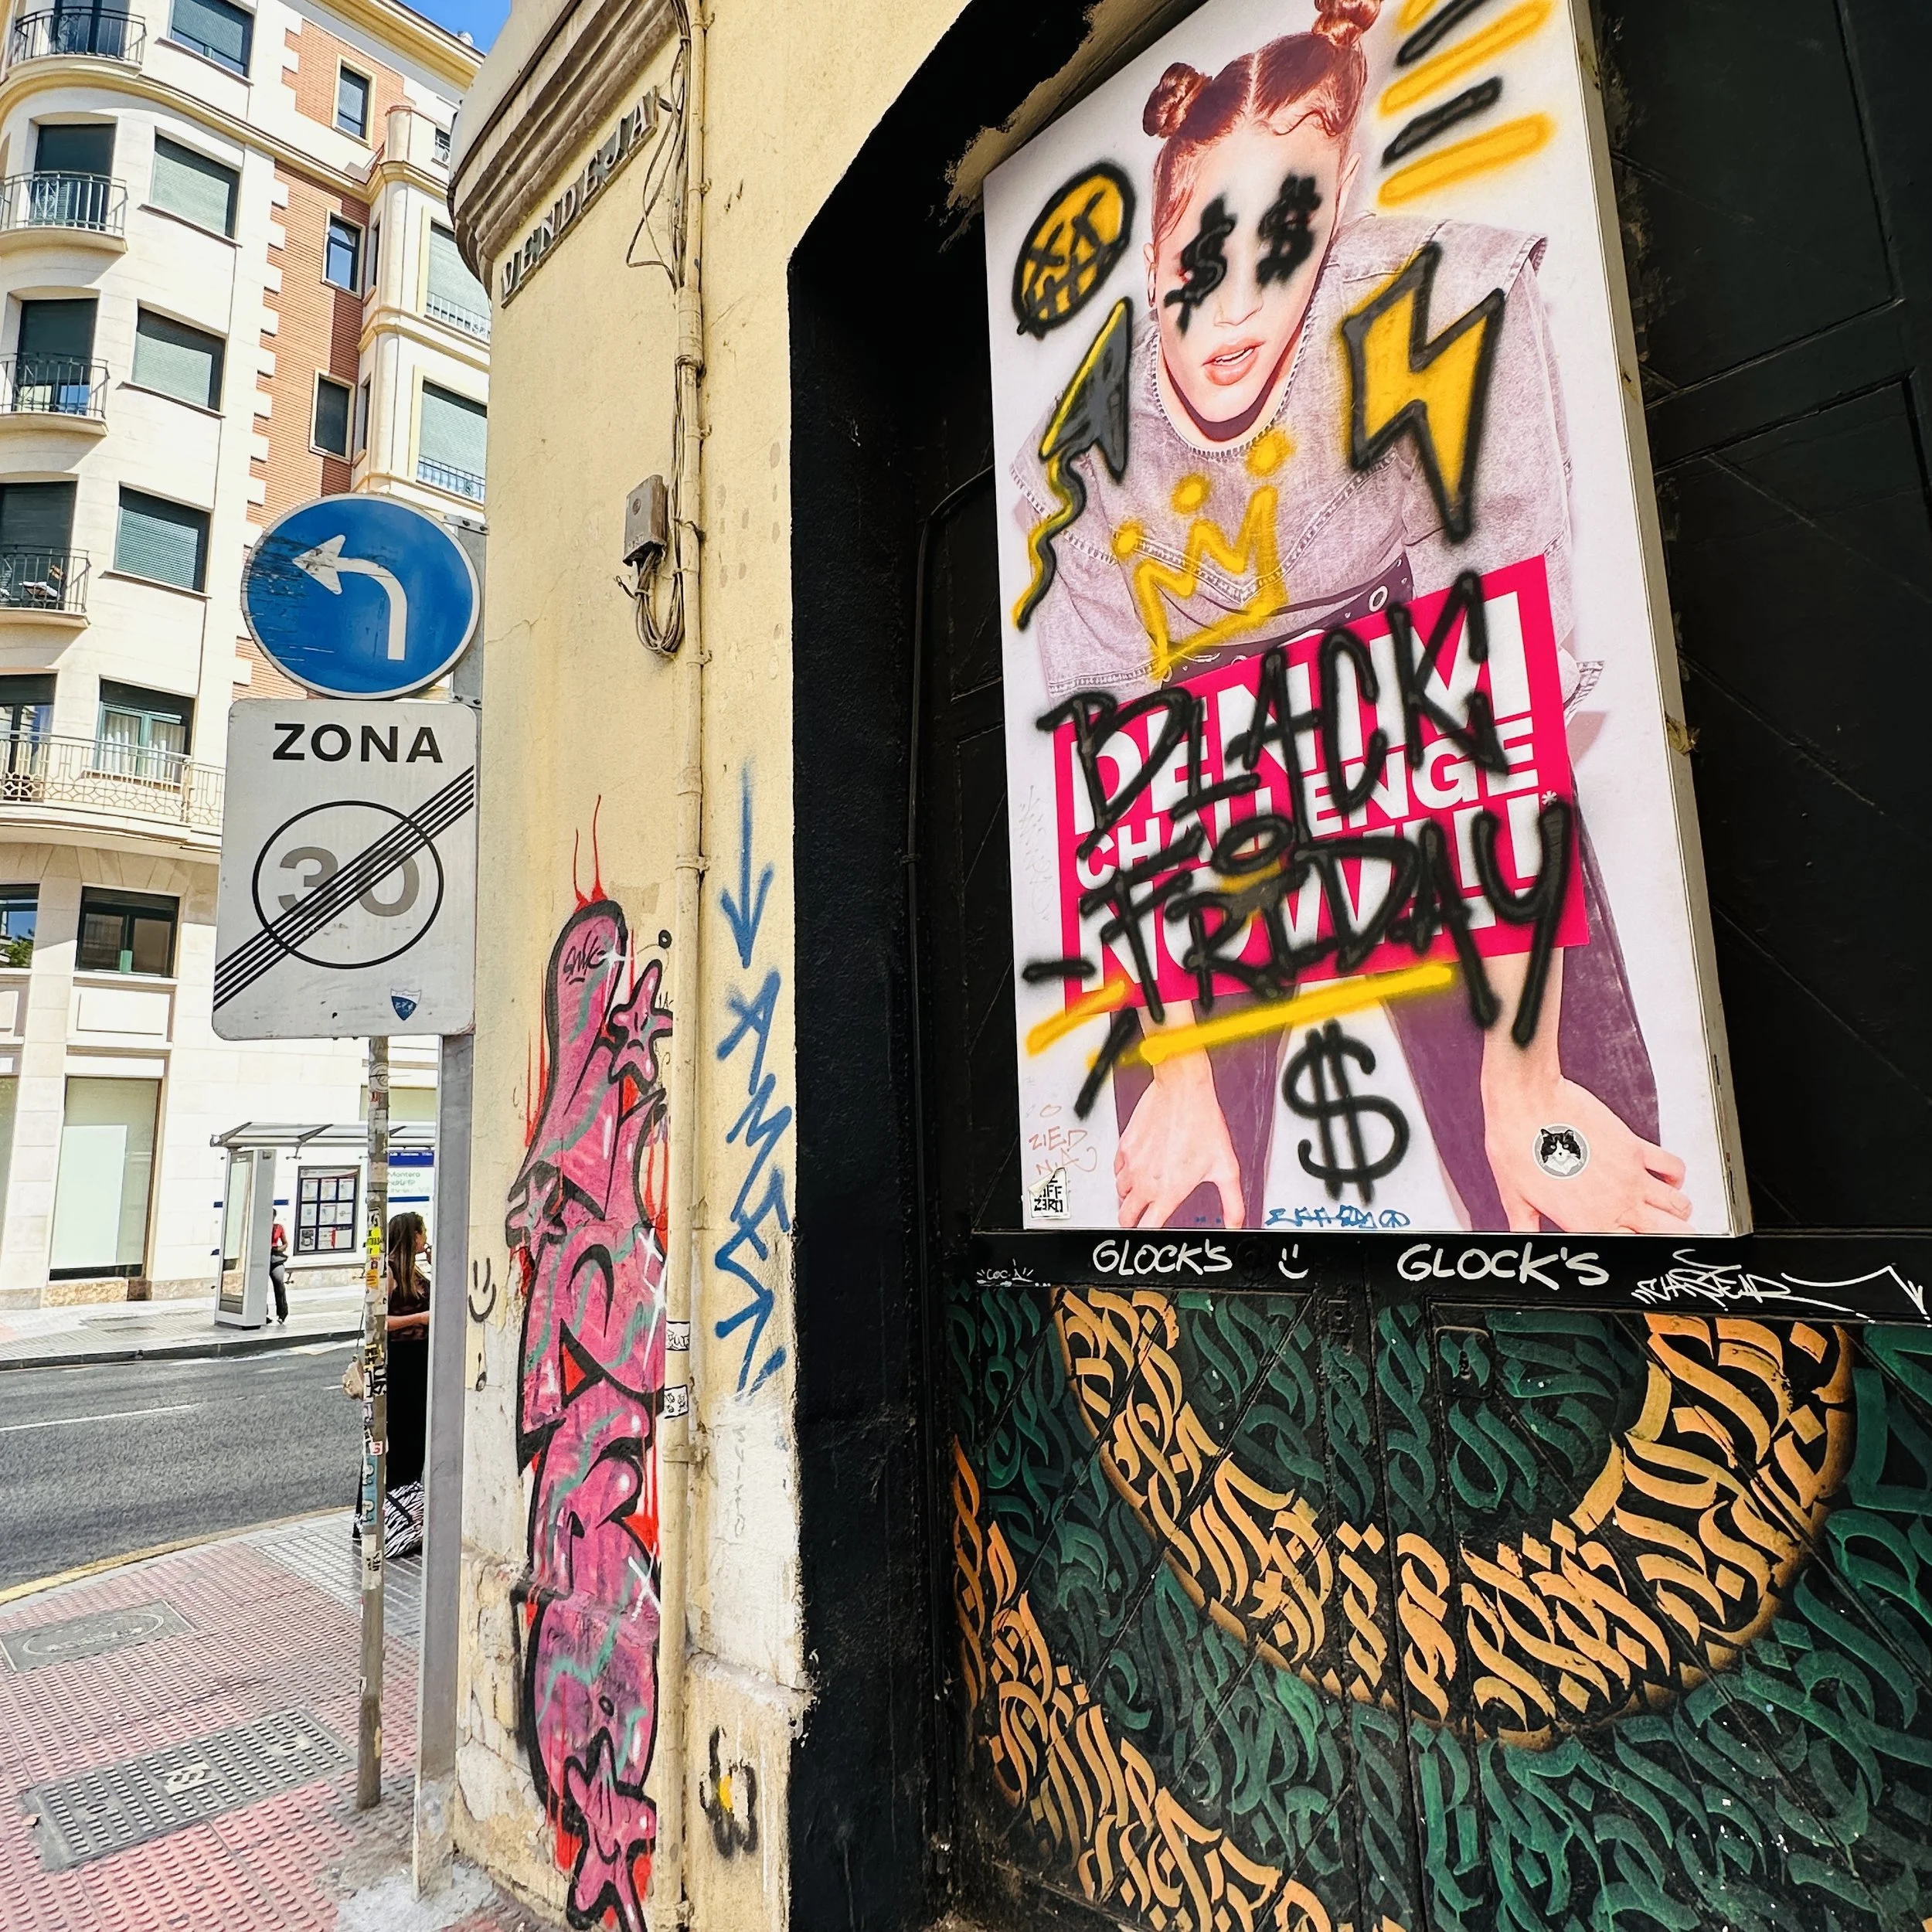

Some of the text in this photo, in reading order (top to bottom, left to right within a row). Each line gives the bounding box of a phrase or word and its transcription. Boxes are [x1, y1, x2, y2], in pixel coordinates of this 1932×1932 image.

[503, 98, 651, 294] VENDEJA
[272, 723, 444, 763] ZONA
[1036, 570, 1511, 861] BLACK
[1070, 591, 1532, 835] DENIM
[277, 846, 420, 918] 30
[1076, 716, 1539, 890] CHALLENGE
[1092, 1239, 1233, 1276] GLOCK'S
[1396, 1241, 1611, 1291] GLOCK'S
